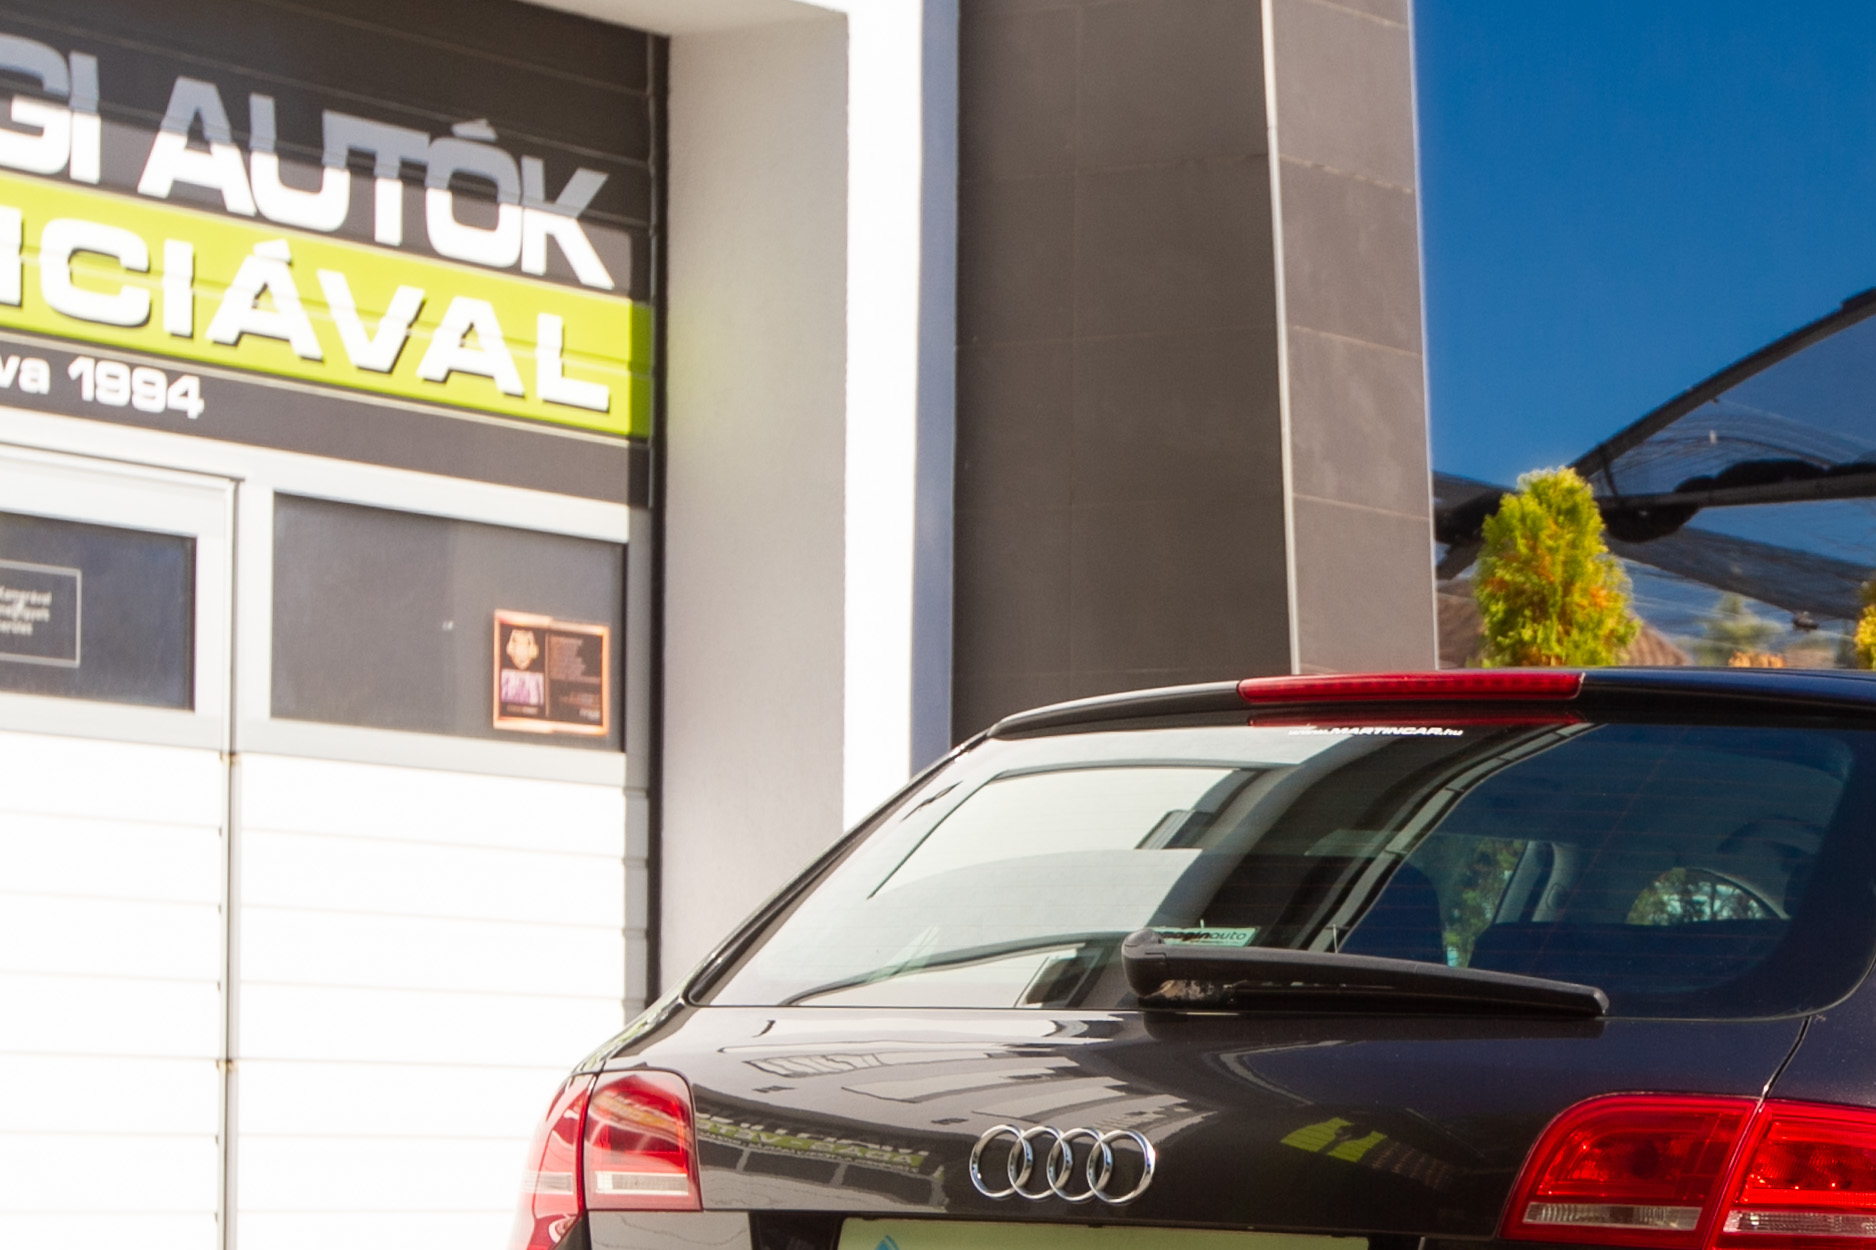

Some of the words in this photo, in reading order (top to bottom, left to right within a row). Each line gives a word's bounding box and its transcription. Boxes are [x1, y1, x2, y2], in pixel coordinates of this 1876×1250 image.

[137, 75, 614, 290] AUTÓK
[0, 205, 611, 412] CIÁVAL
[67, 355, 205, 420] 1994
